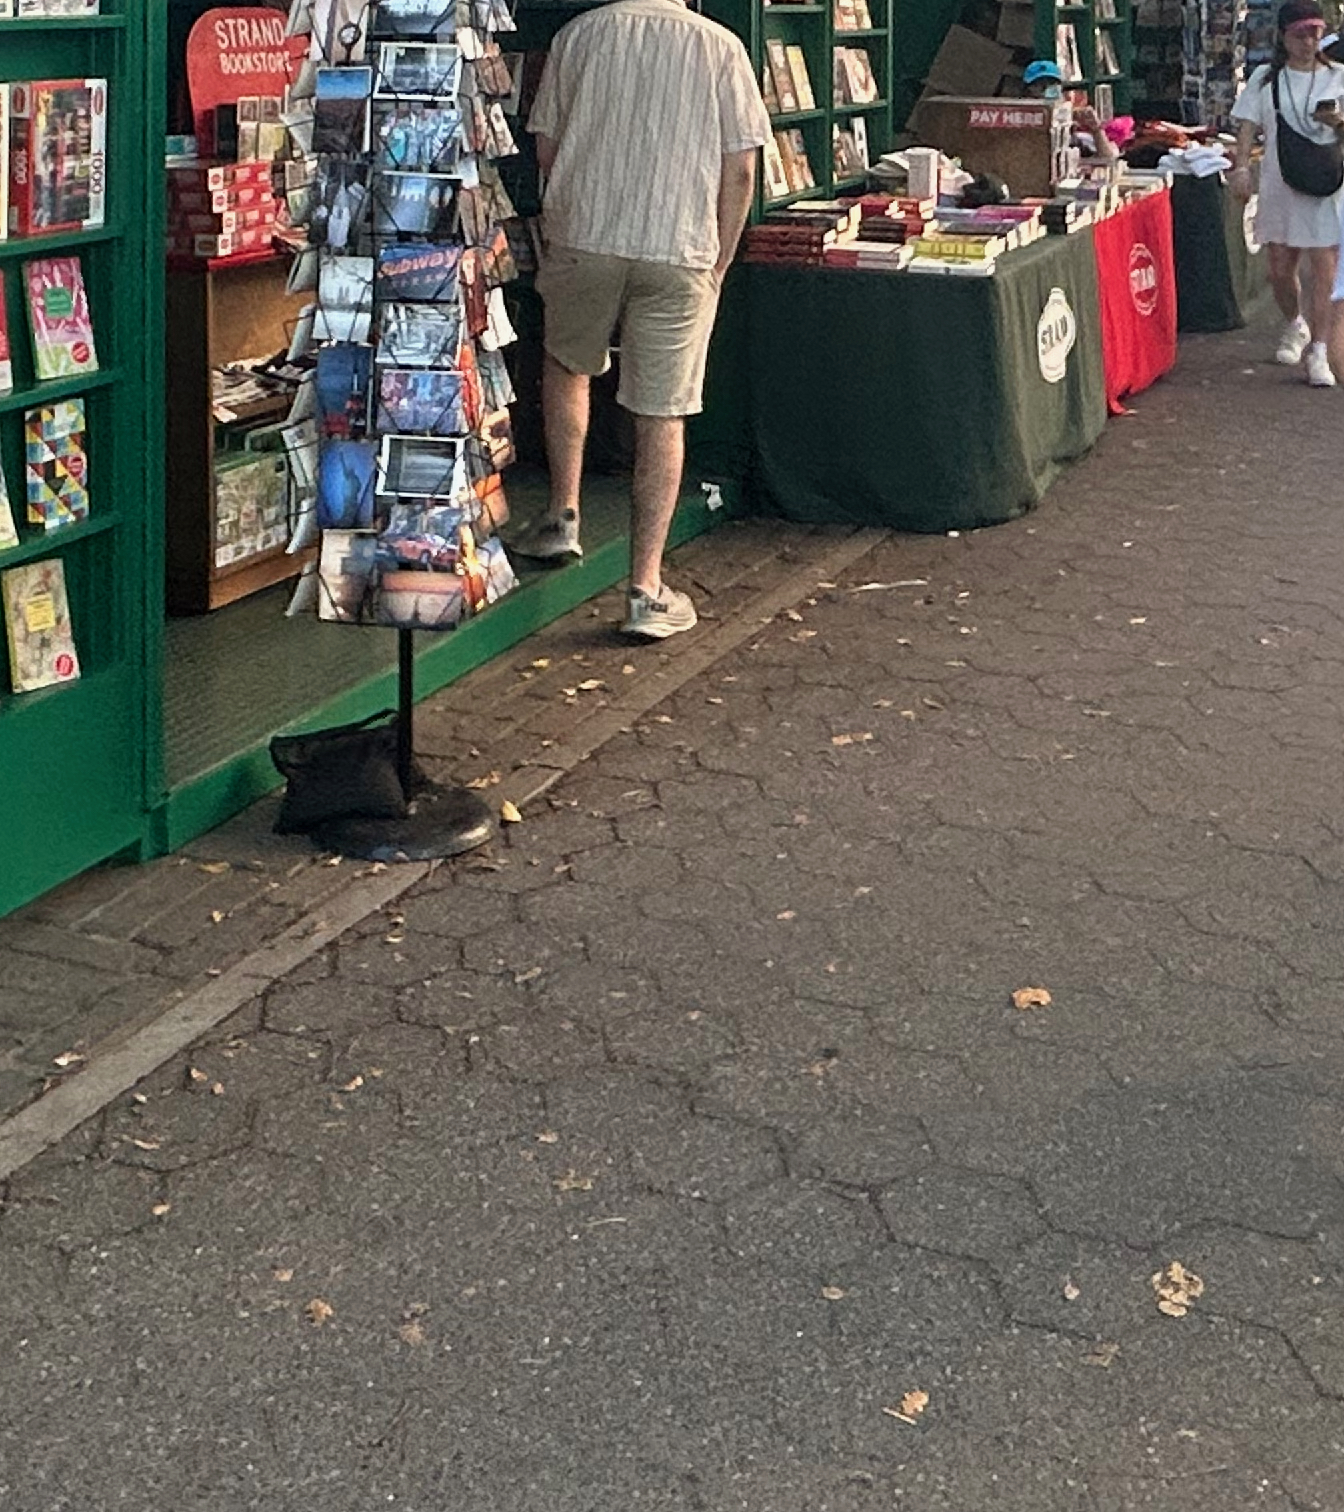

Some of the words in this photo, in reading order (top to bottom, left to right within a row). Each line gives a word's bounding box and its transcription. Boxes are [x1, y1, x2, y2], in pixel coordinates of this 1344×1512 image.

[214, 17, 286, 50] STRAND
[218, 50, 294, 75] BOOKSTORE
[969, 109, 1000, 125] PAY
[1001, 111, 1045, 126] HERE
[91, 149, 105, 195] 1000
